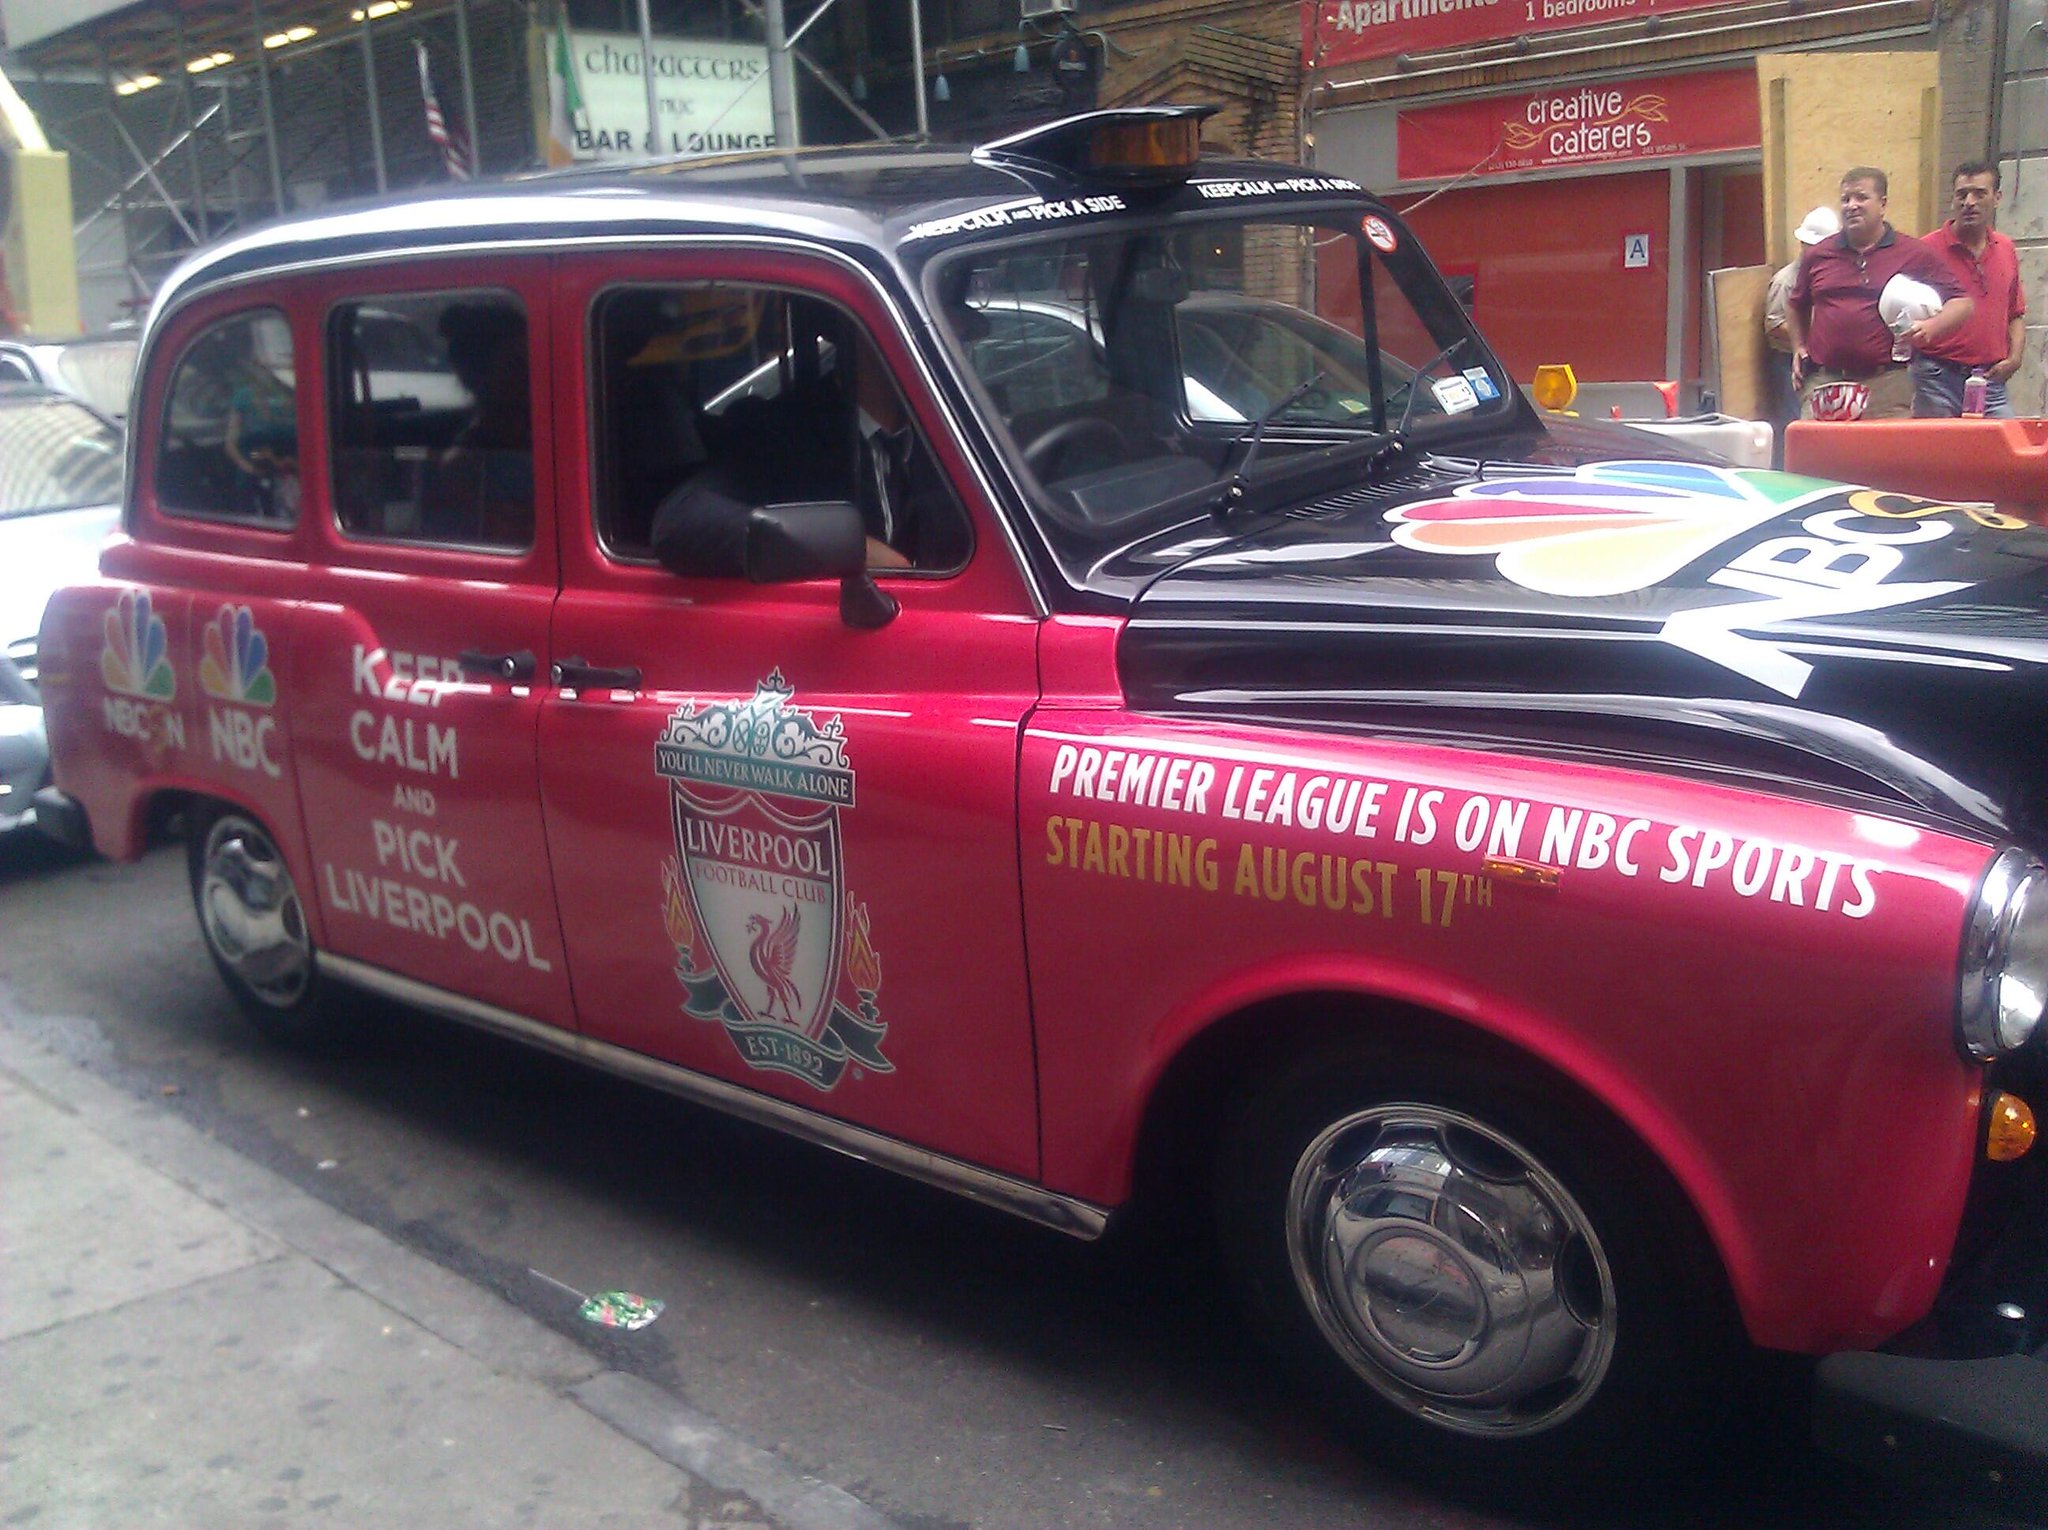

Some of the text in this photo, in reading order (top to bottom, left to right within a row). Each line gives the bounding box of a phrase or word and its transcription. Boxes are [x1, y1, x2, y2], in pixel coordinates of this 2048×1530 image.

[1527, 89, 1622, 124] creative
[577, 129, 632, 151] BAR
[1549, 121, 1651, 155] caterers
[1288, 177, 1321, 192] PICK
[1319, 178, 1333, 190] A
[1029, 202, 1074, 222] PICK
[1071, 199, 1087, 216] A
[1087, 194, 1127, 213] SIDE
[1629, 239, 1645, 259] A
[353, 644, 466, 708] KEEP
[209, 704, 282, 778] NBC
[351, 709, 460, 780] CALM
[703, 756, 750, 783] NEVER
[751, 765, 794, 789] WALK
[798, 772, 850, 798] ALONE
[393, 783, 436, 817] AND
[685, 818, 831, 877] LIVERPOOL
[1048, 743, 1884, 920] PREMIER LEAGUE IS ON NBC SPORTS
[372, 819, 466, 888] PICK
[1045, 814, 1220, 892] STARTING
[1234, 842, 1399, 920] AUGUST
[694, 864, 827, 904] FOOTBALL CLUB
[324, 862, 551, 972] LIVERPOOL
